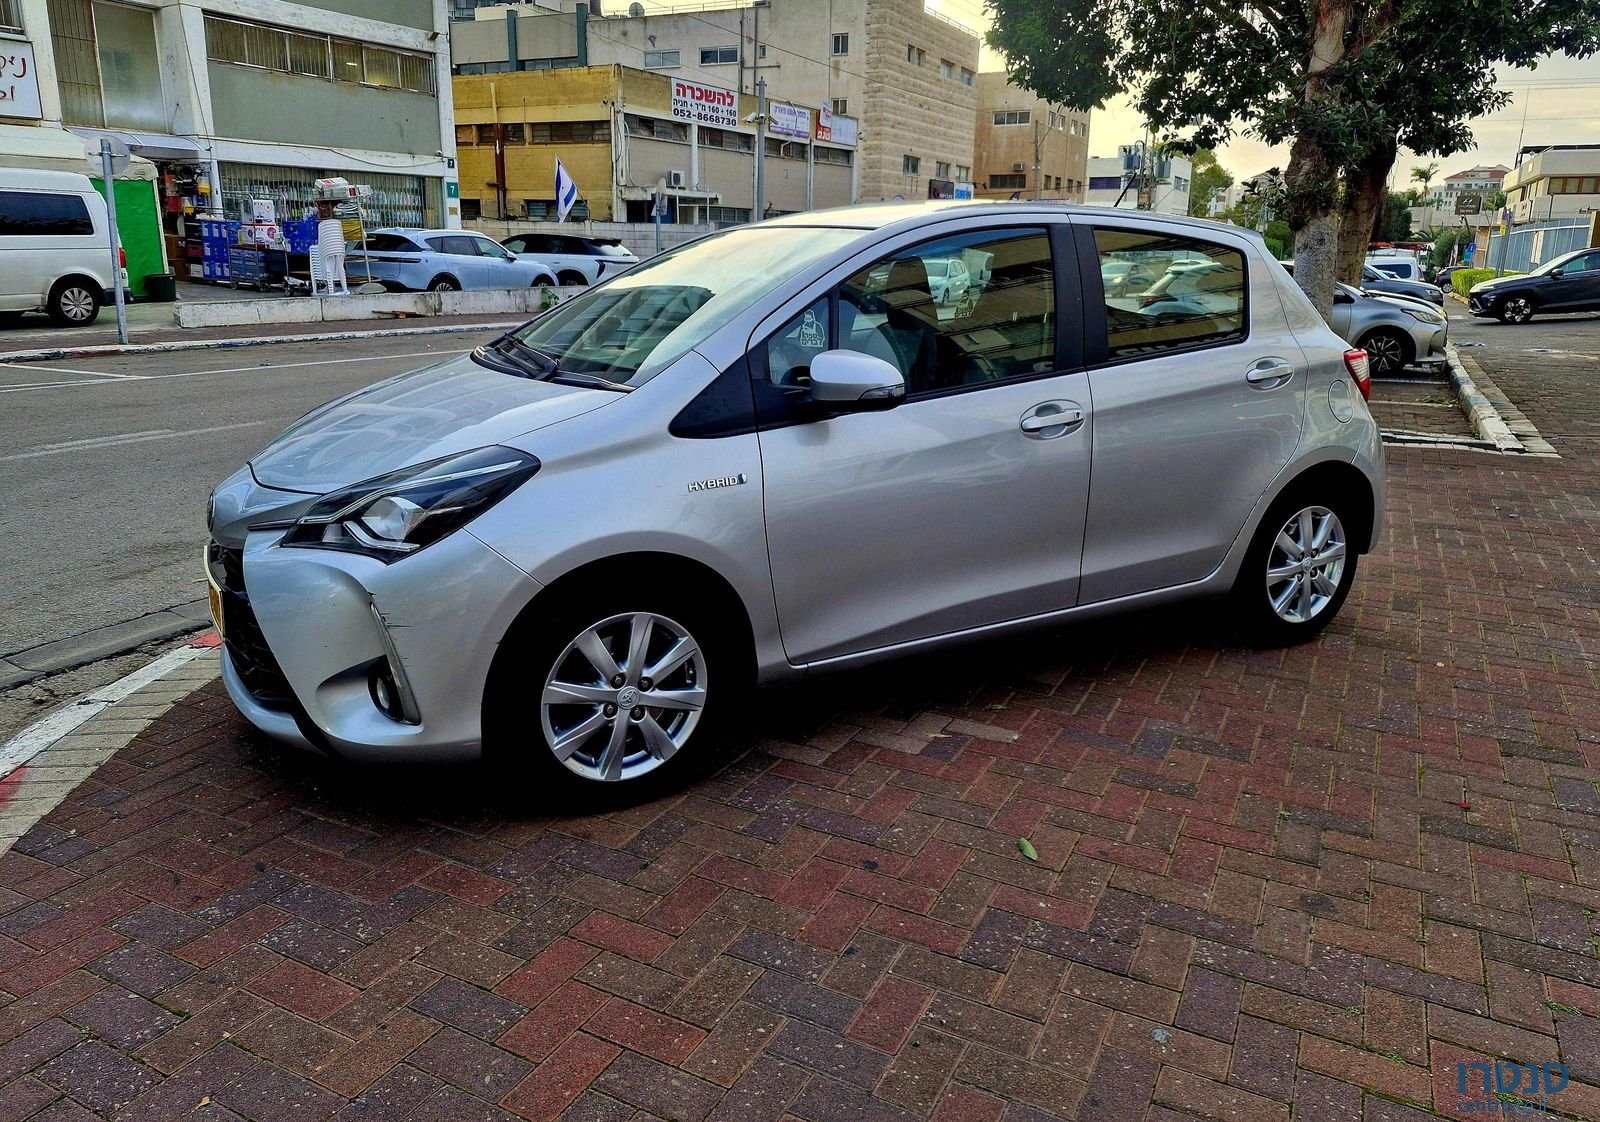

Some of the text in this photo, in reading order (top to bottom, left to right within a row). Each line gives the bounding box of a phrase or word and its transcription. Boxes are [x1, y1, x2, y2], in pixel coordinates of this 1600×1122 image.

[673, 98, 688, 108] חניה
[676, 83, 734, 107] להשכרה
[673, 108, 737, 127] 052-8668730
[708, 105, 720, 114] 160
[688, 476, 738, 493] HYBRID
